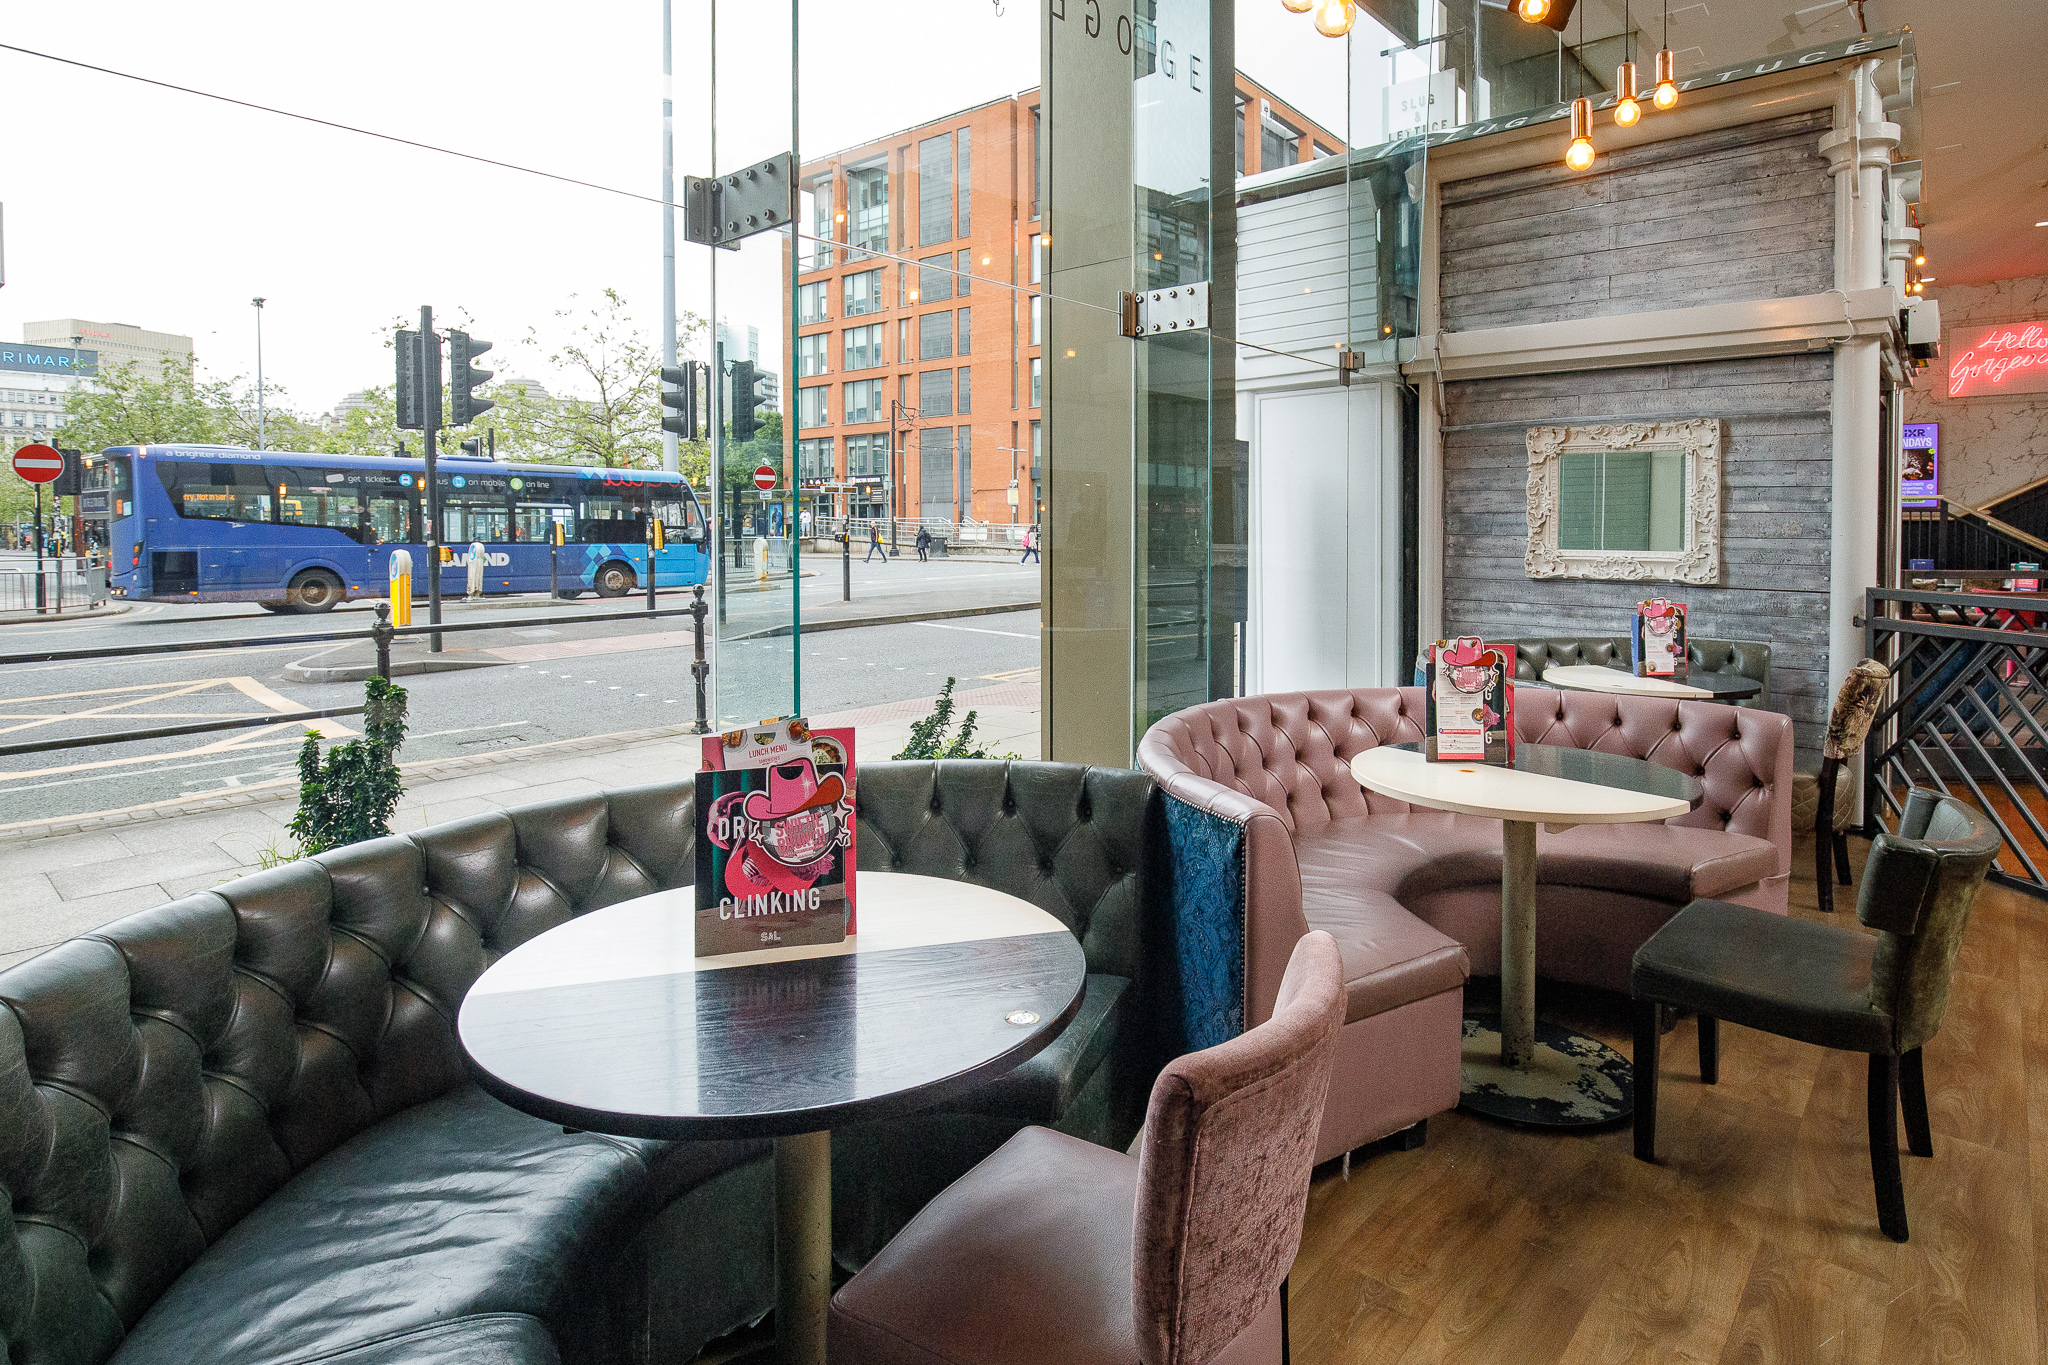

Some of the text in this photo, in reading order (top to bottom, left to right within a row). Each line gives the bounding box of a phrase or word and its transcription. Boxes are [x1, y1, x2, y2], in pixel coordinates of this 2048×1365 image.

[1401, 93, 1435, 112] SLUG
[1411, 116, 1529, 149] SLUG
[1599, 40, 1873, 108] LETTUCE
[1388, 119, 1448, 142] LETTUCE
[1978, 325, 2048, 352] Hello
[2, 351, 85, 369] RIMARK
[1951, 351, 2048, 394] Gorgeou
[1902, 437, 1933, 447] NDAYS
[1904, 428, 1926, 437] iXR
[174, 450, 216, 459] brighter
[218, 451, 261, 460] diamond
[347, 475, 361, 484] get
[480, 478, 506, 486] mobile
[525, 480, 536, 488] on
[536, 479, 550, 489] line
[748, 743, 788, 759] LUNCH MENU
[774, 811, 825, 837] SWIFTIE
[776, 828, 827, 854] BRUNCH
[719, 887, 821, 921] CLINKING
[760, 930, 782, 942] S&L
